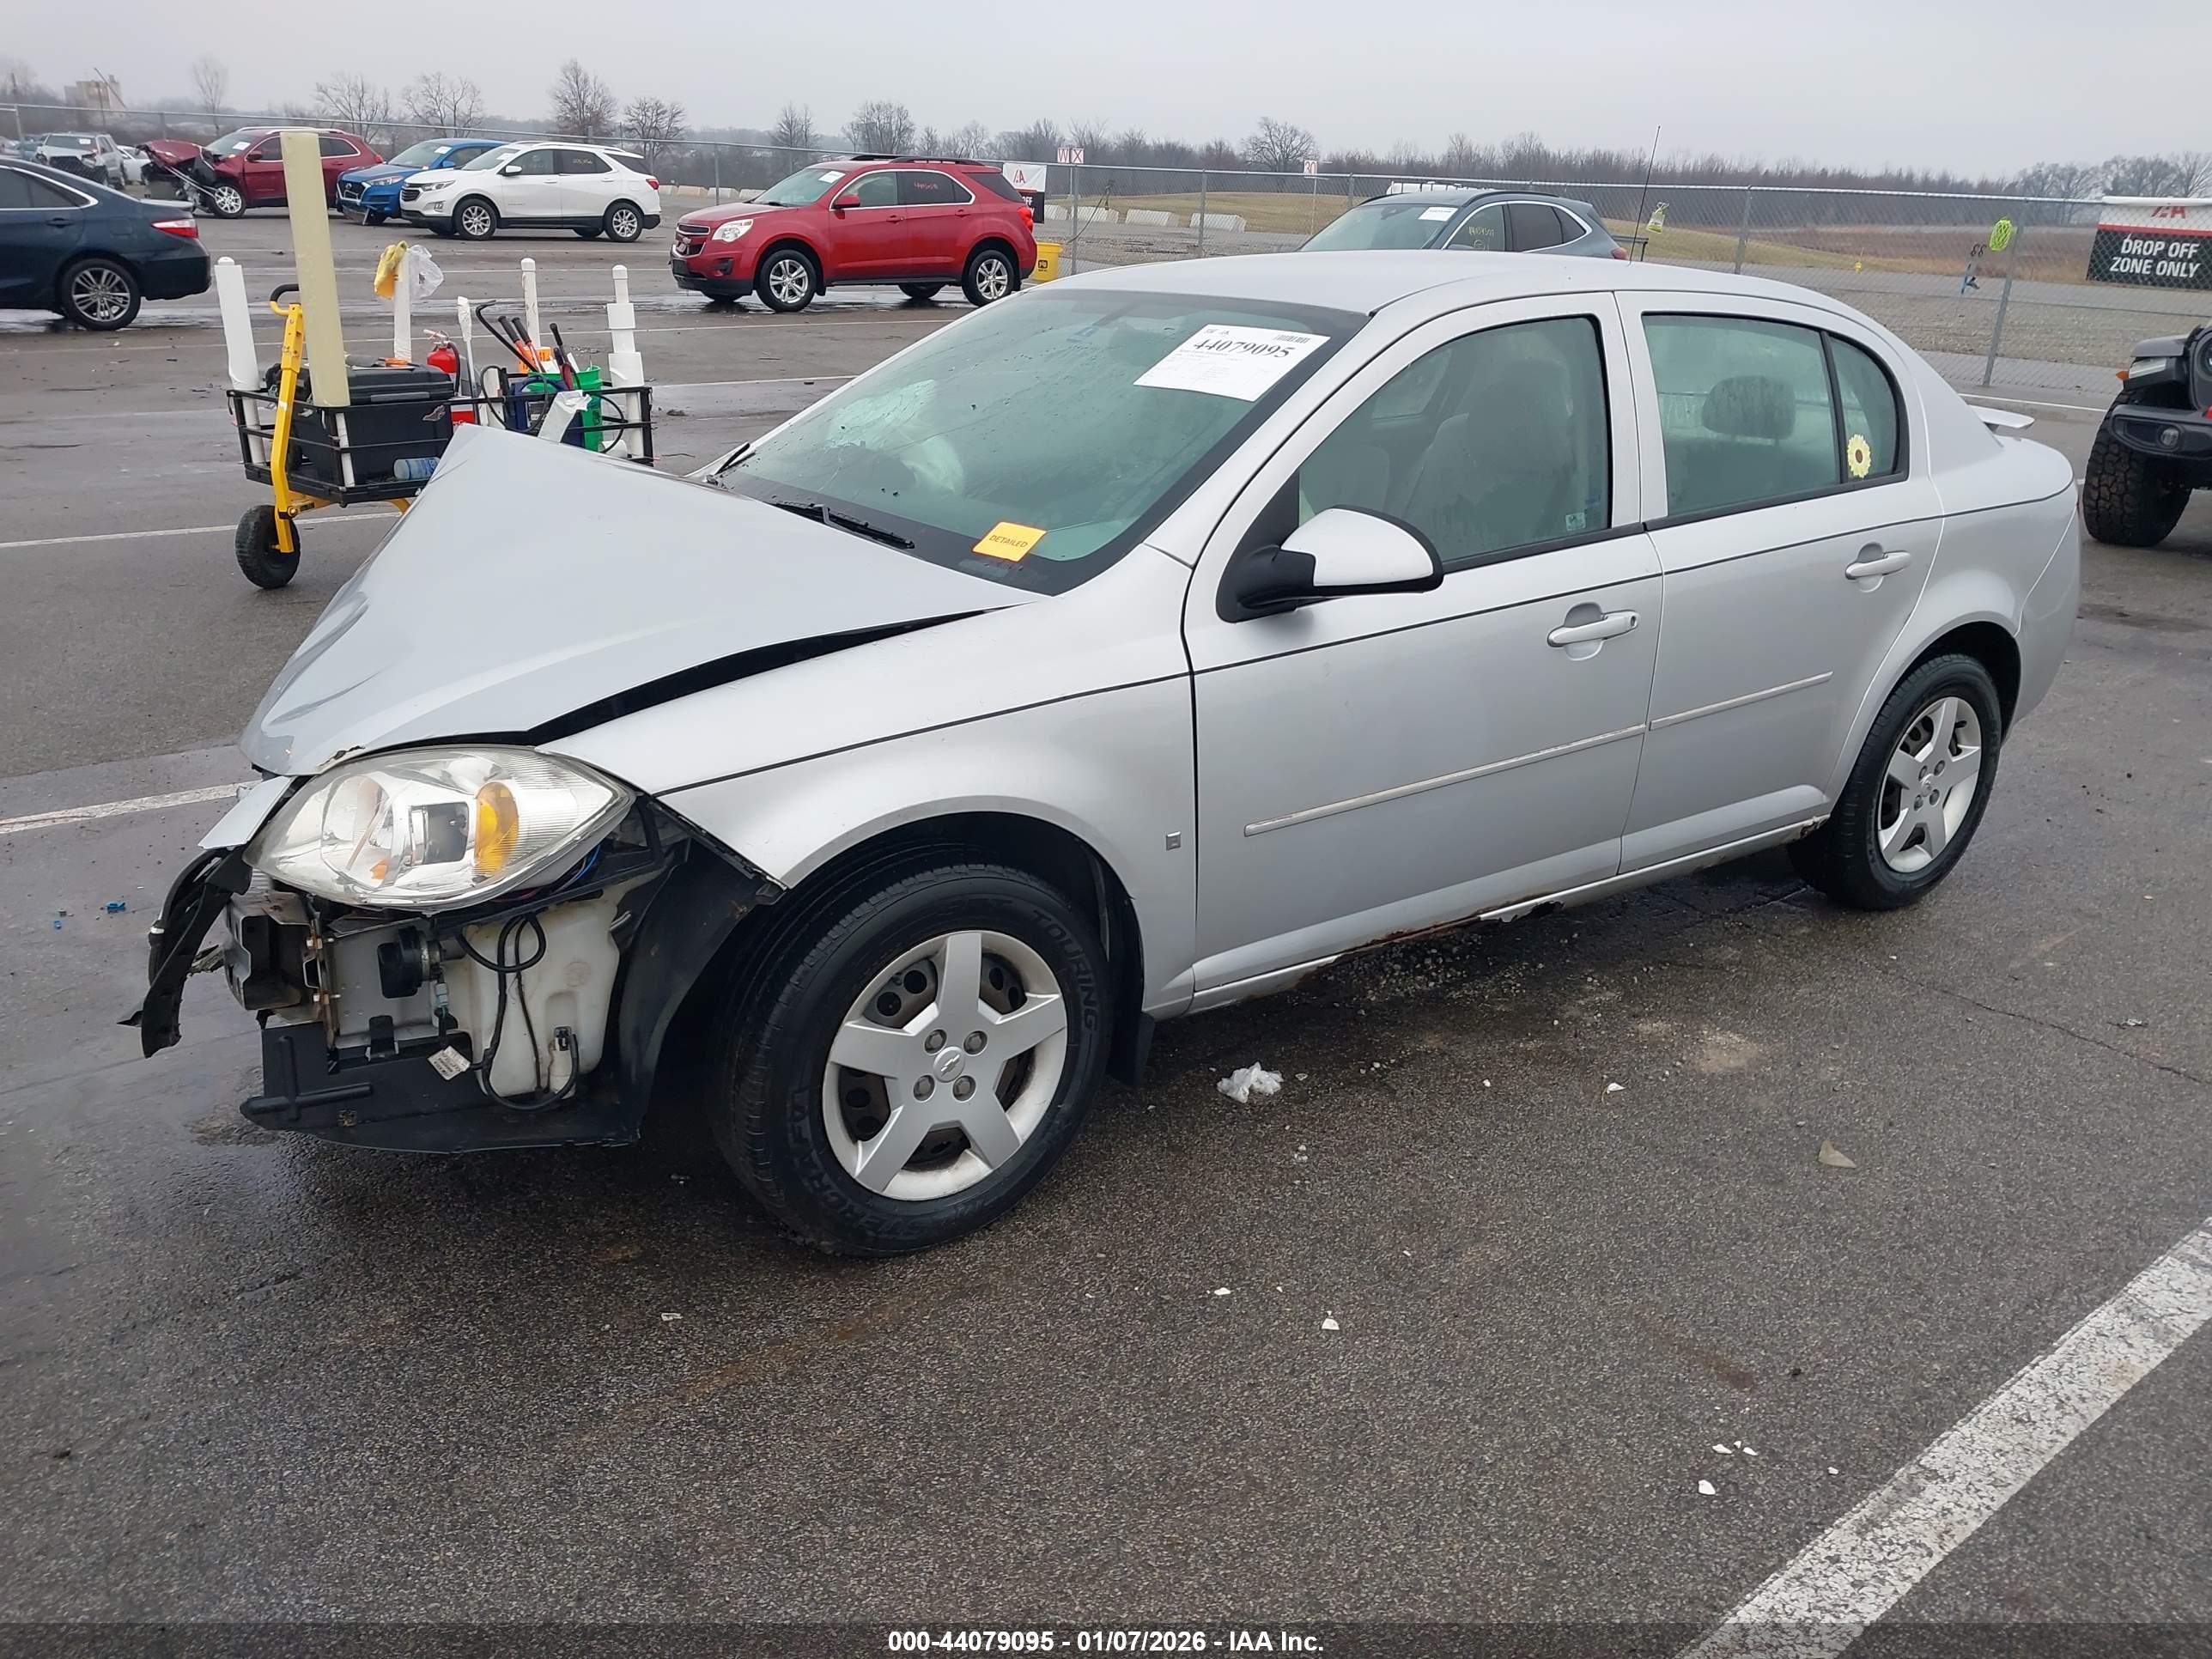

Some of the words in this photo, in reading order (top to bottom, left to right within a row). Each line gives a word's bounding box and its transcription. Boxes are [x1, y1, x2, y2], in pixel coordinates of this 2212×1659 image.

[1058, 149, 1070, 162] W
[1073, 149, 1083, 162] X
[1305, 161, 1316, 174] 30
[2121, 239, 2165, 256] DROP
[2168, 242, 2199, 258] OFF
[2110, 257, 2154, 274] ZONE
[2156, 260, 2201, 277] ONLY
[1194, 338, 1296, 358] 44079095
[989, 534, 1028, 548] DETAILED
[1033, 909, 1098, 1030] TOURING
